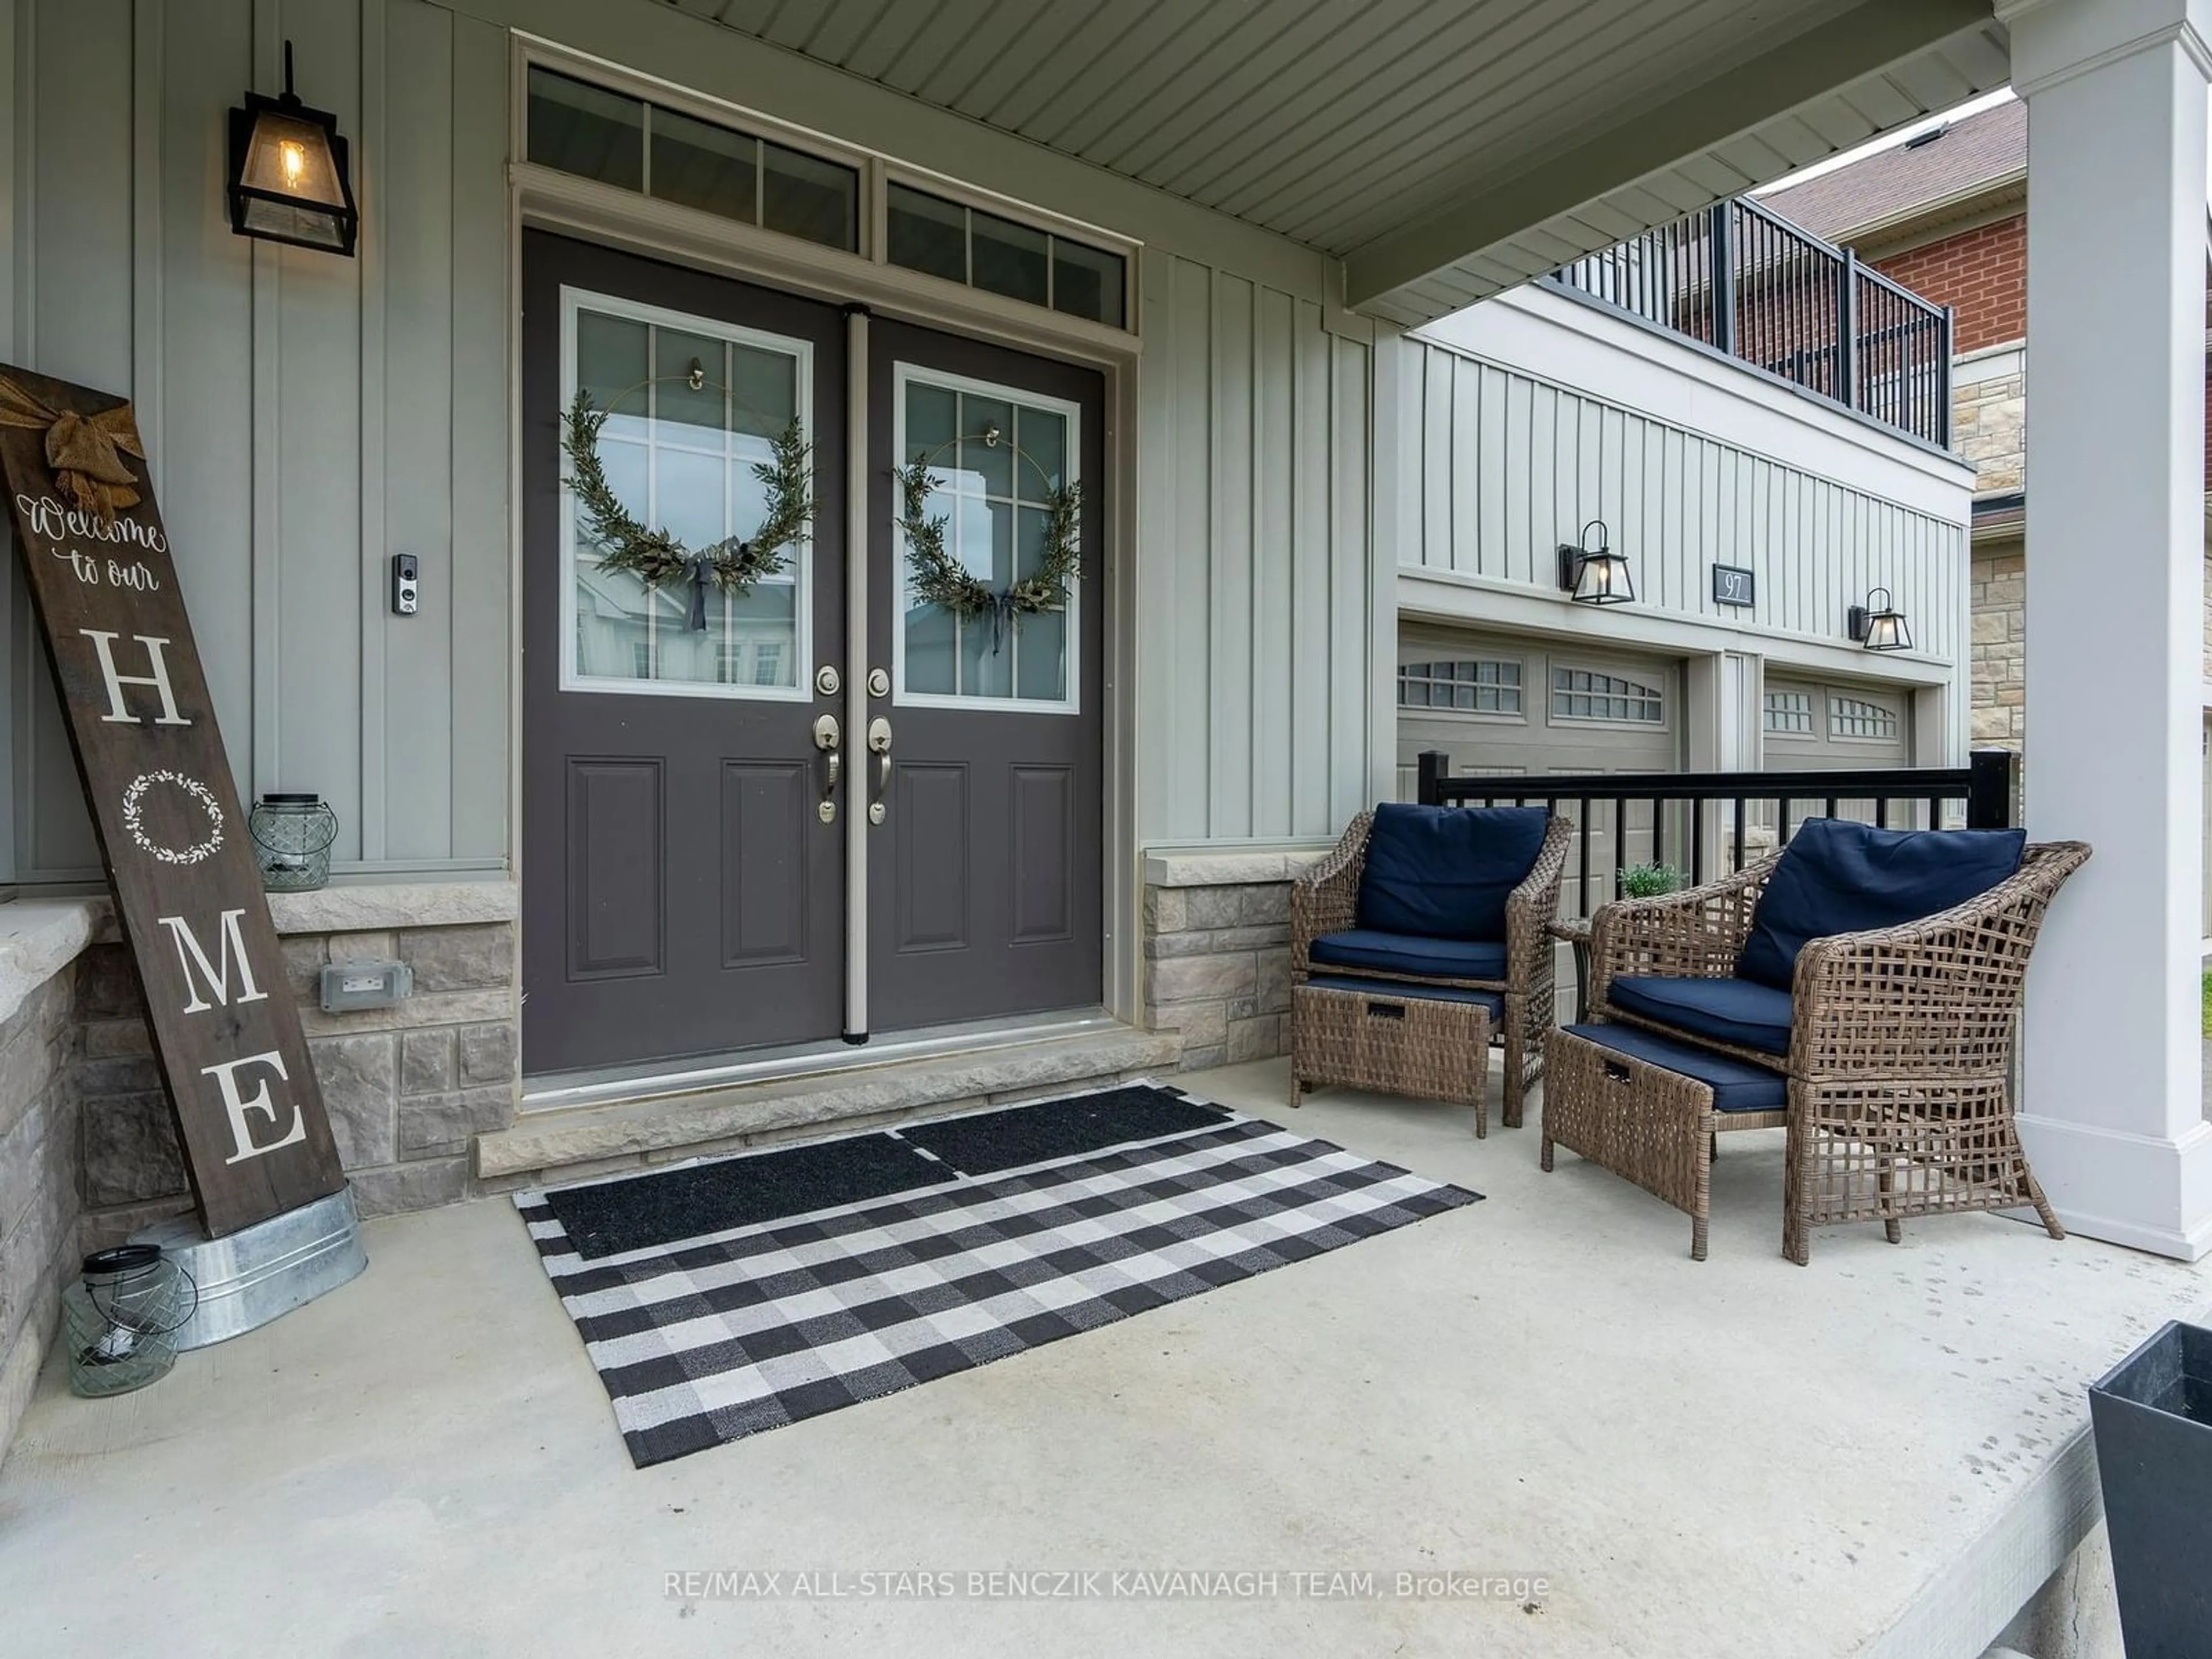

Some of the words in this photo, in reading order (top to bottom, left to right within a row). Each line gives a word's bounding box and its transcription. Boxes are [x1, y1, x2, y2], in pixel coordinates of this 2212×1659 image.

[17, 494, 166, 552] Welcome
[51, 547, 99, 584] to
[108, 559, 159, 591] our
[1725, 574, 1741, 599] 97
